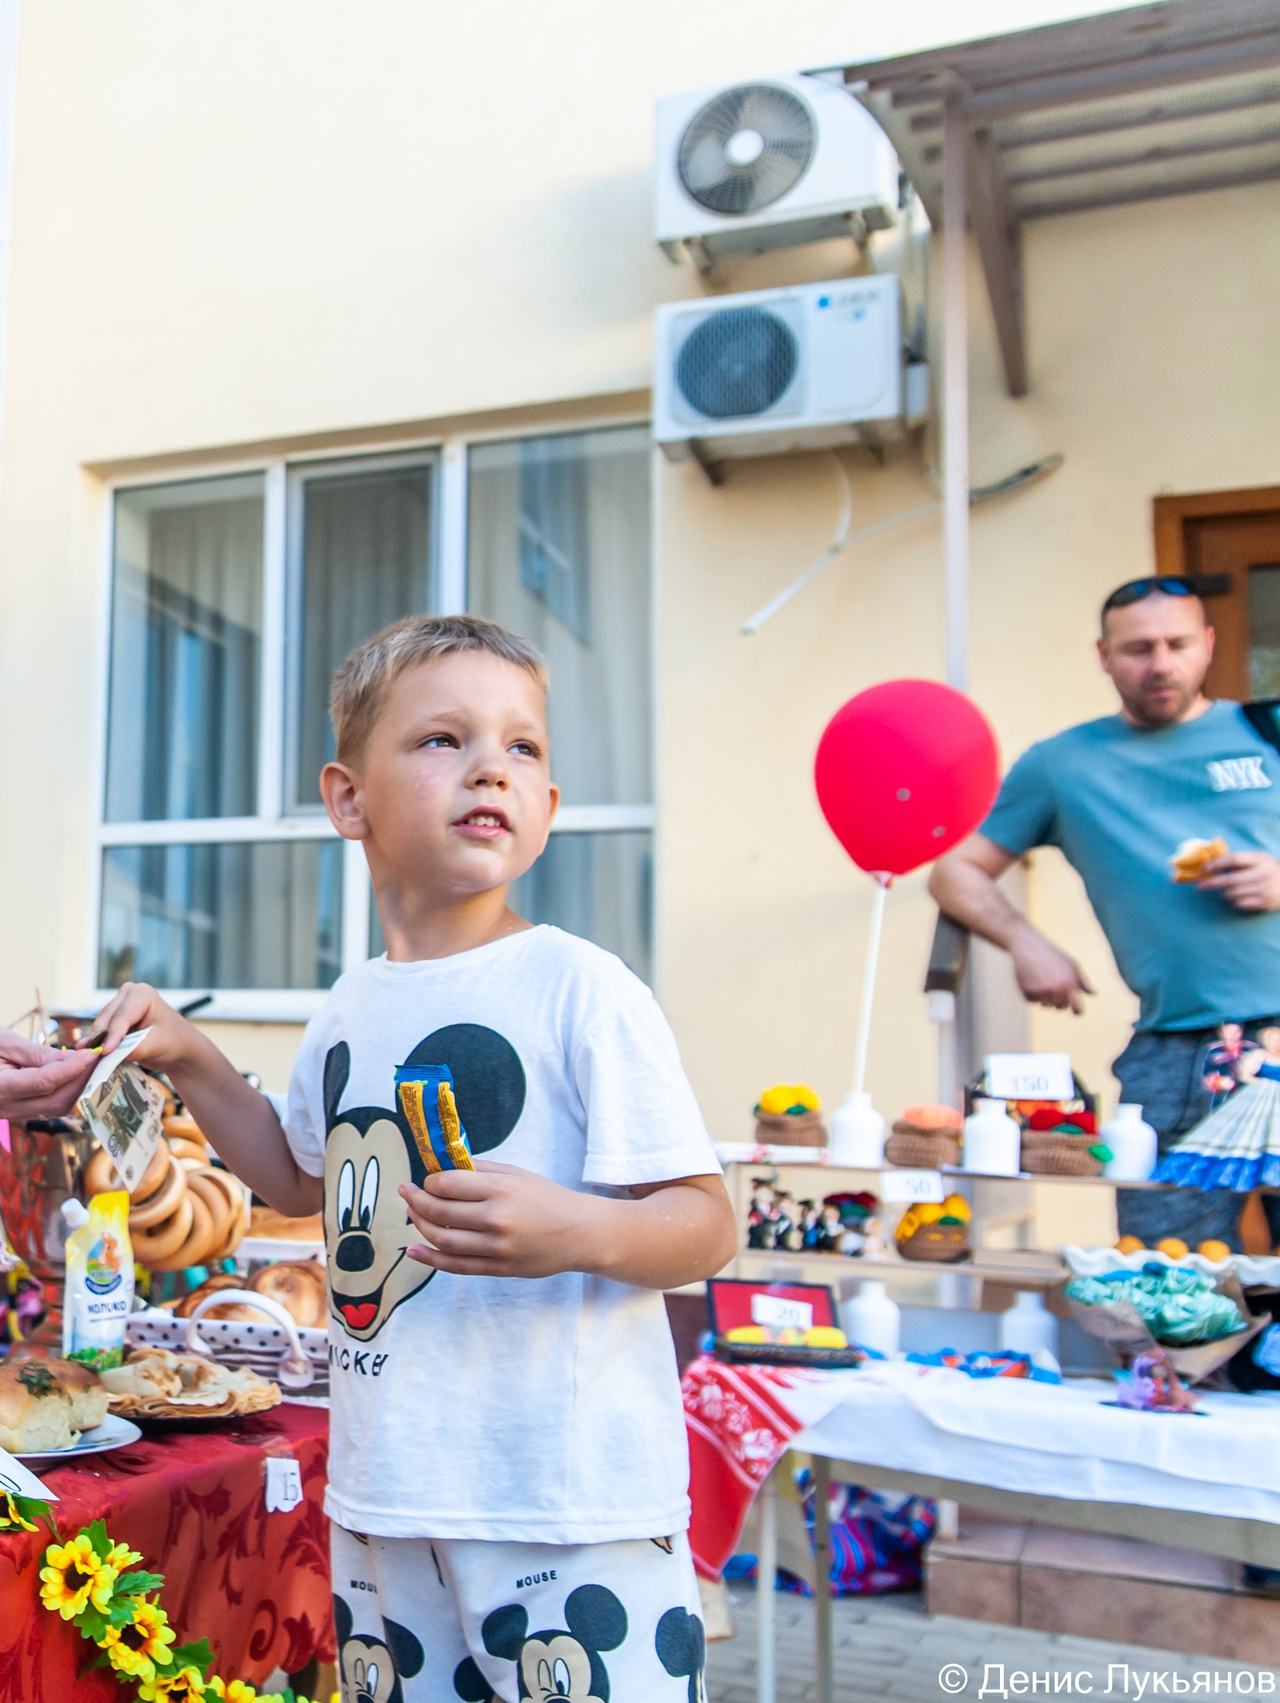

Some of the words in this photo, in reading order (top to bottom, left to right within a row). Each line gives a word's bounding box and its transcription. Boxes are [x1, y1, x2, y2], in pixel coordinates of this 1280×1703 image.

[1011, 1074, 1049, 1093] 150
[282, 1472, 300, 1502] 15
[516, 1570, 558, 1589] MOUSE
